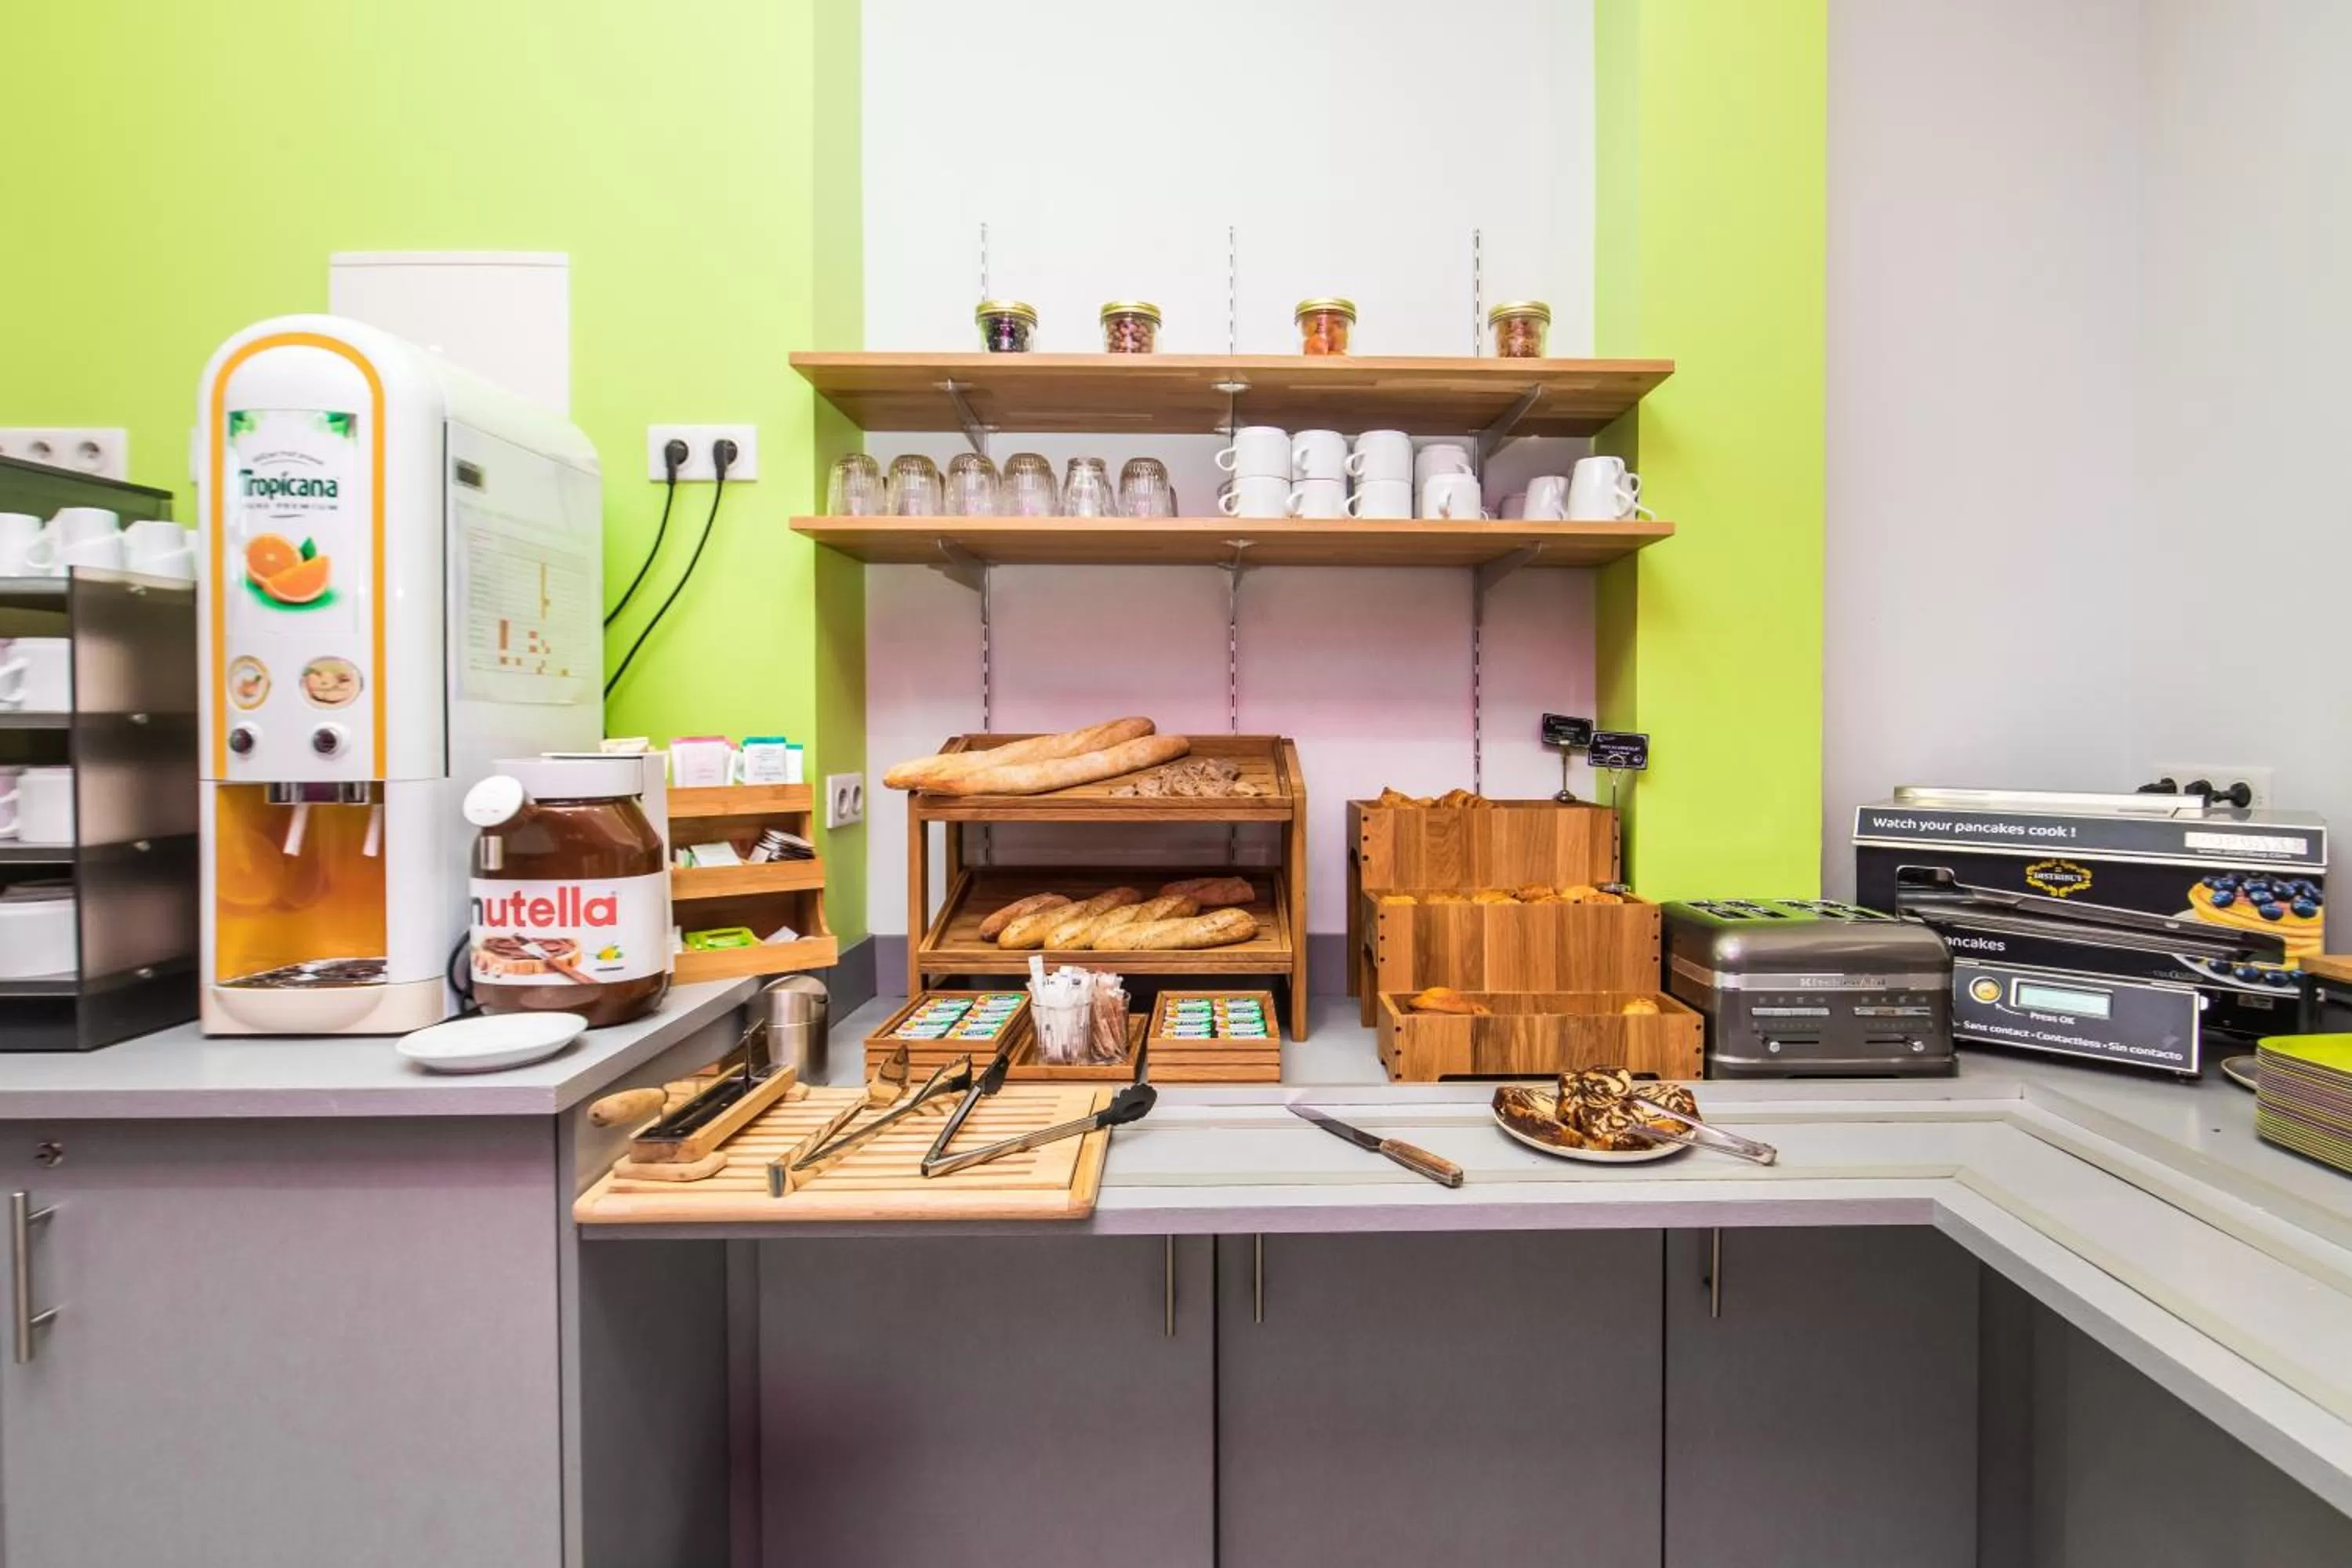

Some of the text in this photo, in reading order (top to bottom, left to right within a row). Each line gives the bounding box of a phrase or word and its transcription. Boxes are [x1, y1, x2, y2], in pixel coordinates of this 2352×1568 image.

[240, 469, 338, 499] Tropicana
[1872, 817, 1917, 829] Watch
[1918, 820, 1952, 832] your
[1955, 822, 2025, 835] pancakes
[2029, 826, 2067, 837] cook
[471, 886, 618, 928] nutella
[2030, 1011, 2076, 1025] Press OK
[1962, 1020, 2184, 1062] Sans contact Contactless Sin contacto
